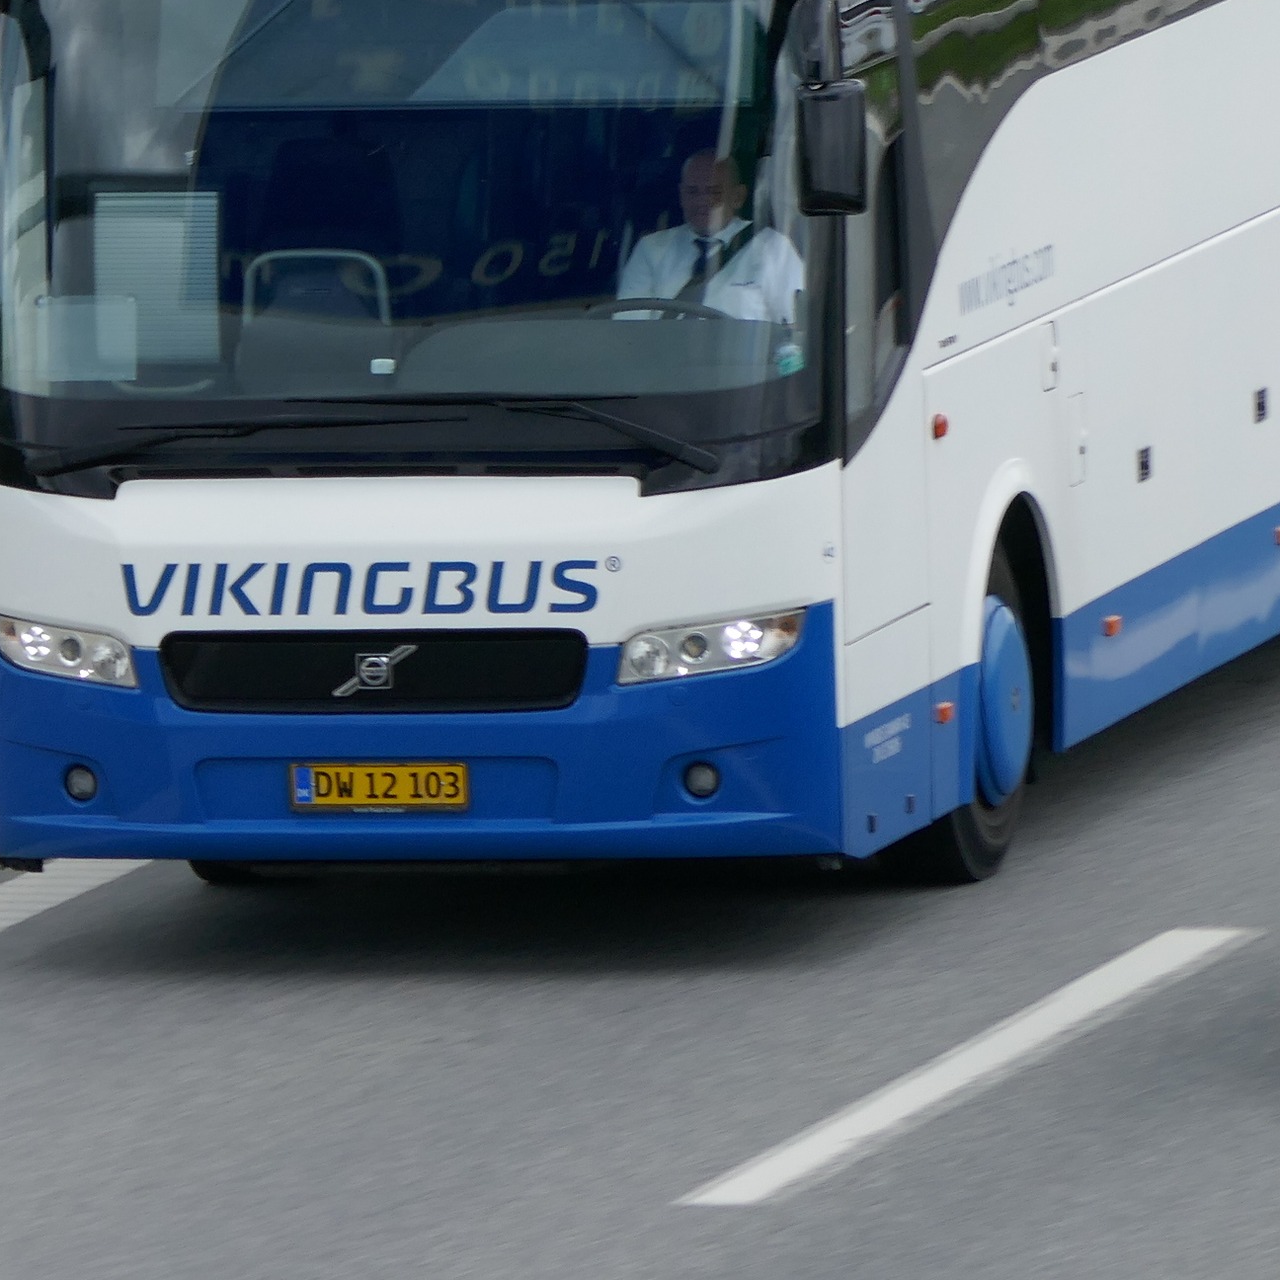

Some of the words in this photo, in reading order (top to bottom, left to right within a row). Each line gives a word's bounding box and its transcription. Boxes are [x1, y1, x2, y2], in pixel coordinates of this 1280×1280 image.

[314, 771, 354, 799] DW
[364, 772, 398, 799] 12
[408, 771, 460, 799] 103
